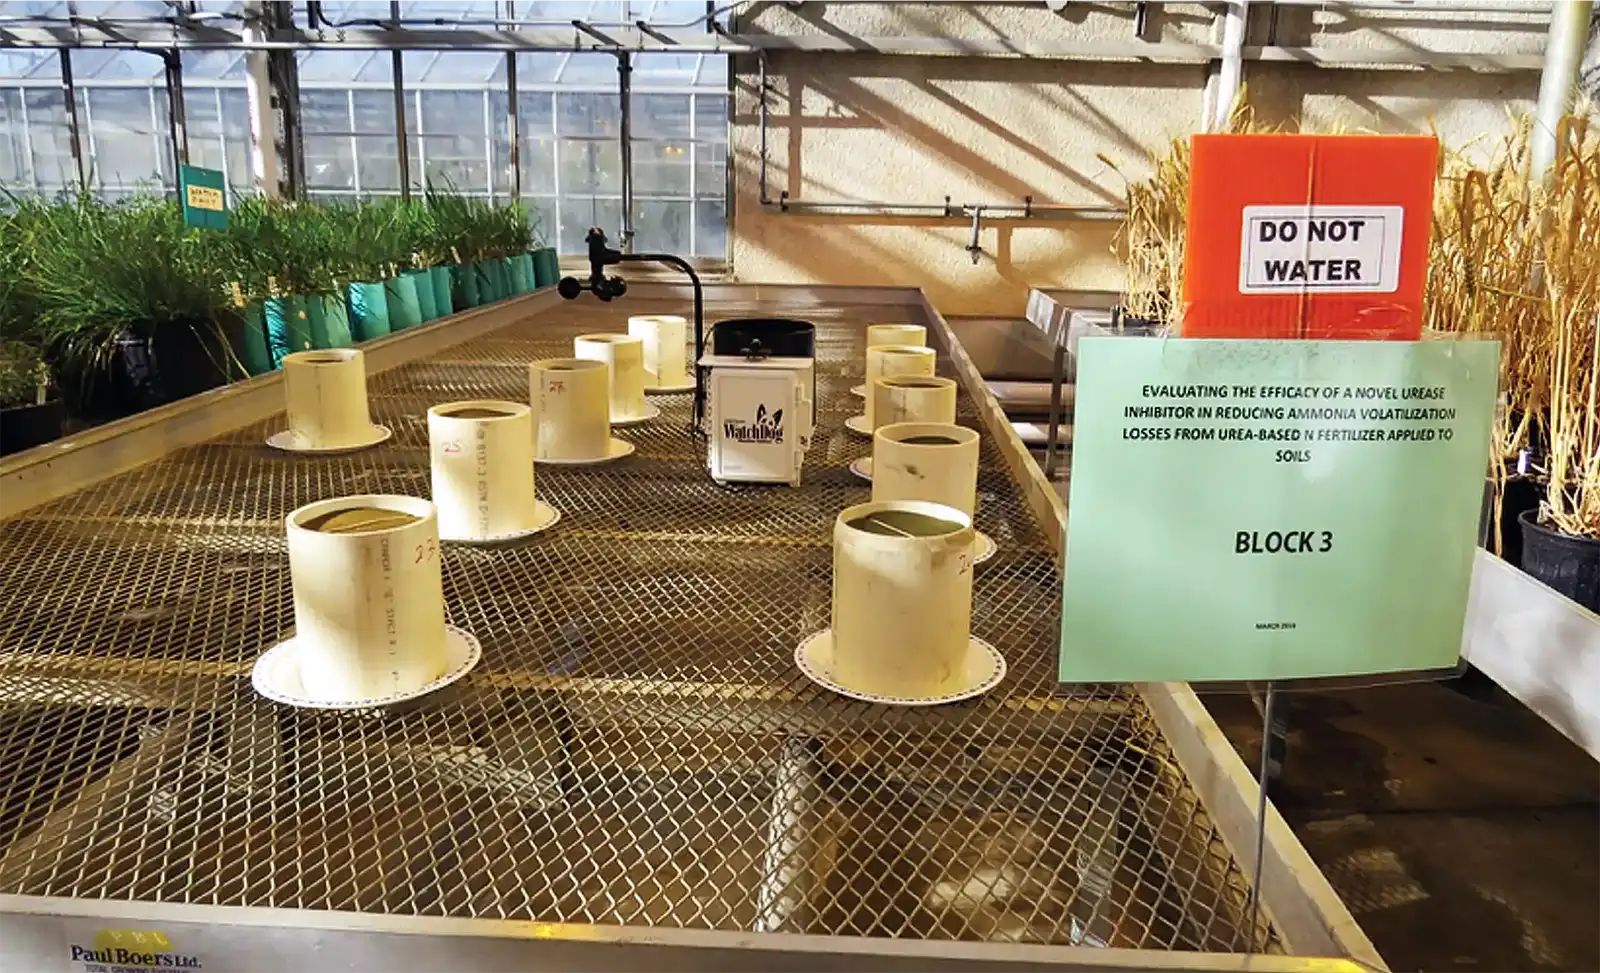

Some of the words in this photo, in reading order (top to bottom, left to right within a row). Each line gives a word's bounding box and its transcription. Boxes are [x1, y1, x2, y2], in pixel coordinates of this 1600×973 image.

[1259, 220, 1298, 242] DO
[1308, 220, 1365, 242] NOT
[1264, 259, 1362, 281] WATER
[1142, 385, 1228, 398] EVALUATING
[1232, 386, 1256, 398] THE
[1259, 386, 1319, 399] EFFICACY
[1322, 387, 1340, 399] OF
[1343, 388, 1353, 399] A
[1355, 387, 1398, 400] NOVEL
[1402, 387, 1446, 400] UREASE
[1124, 406, 1195, 418] INHIBITOR
[1197, 407, 1212, 418] IN
[1215, 407, 1284, 419] REDUCING
[1287, 408, 1357, 420] AMMONIA
[1360, 408, 1456, 420] VOLATILIZATION
[723, 423, 784, 444] WatchDog
[1122, 428, 1171, 440] LOSSES
[1173, 428, 1215, 440] FROM
[1218, 428, 1300, 441] UREA-BASED
[1304, 430, 1314, 441] N
[1317, 429, 1385, 441] FERTILIZER
[1386, 429, 1435, 441] APPLIED
[1438, 428, 1454, 440] TO
[1275, 450, 1311, 462] SOILS
[1235, 531, 1315, 553] BLOCK
[1319, 531, 1333, 552] 3
[70, 944, 113, 963] Paul
[115, 948, 174, 966] Boers
[175, 956, 202, 969] Ltd.
